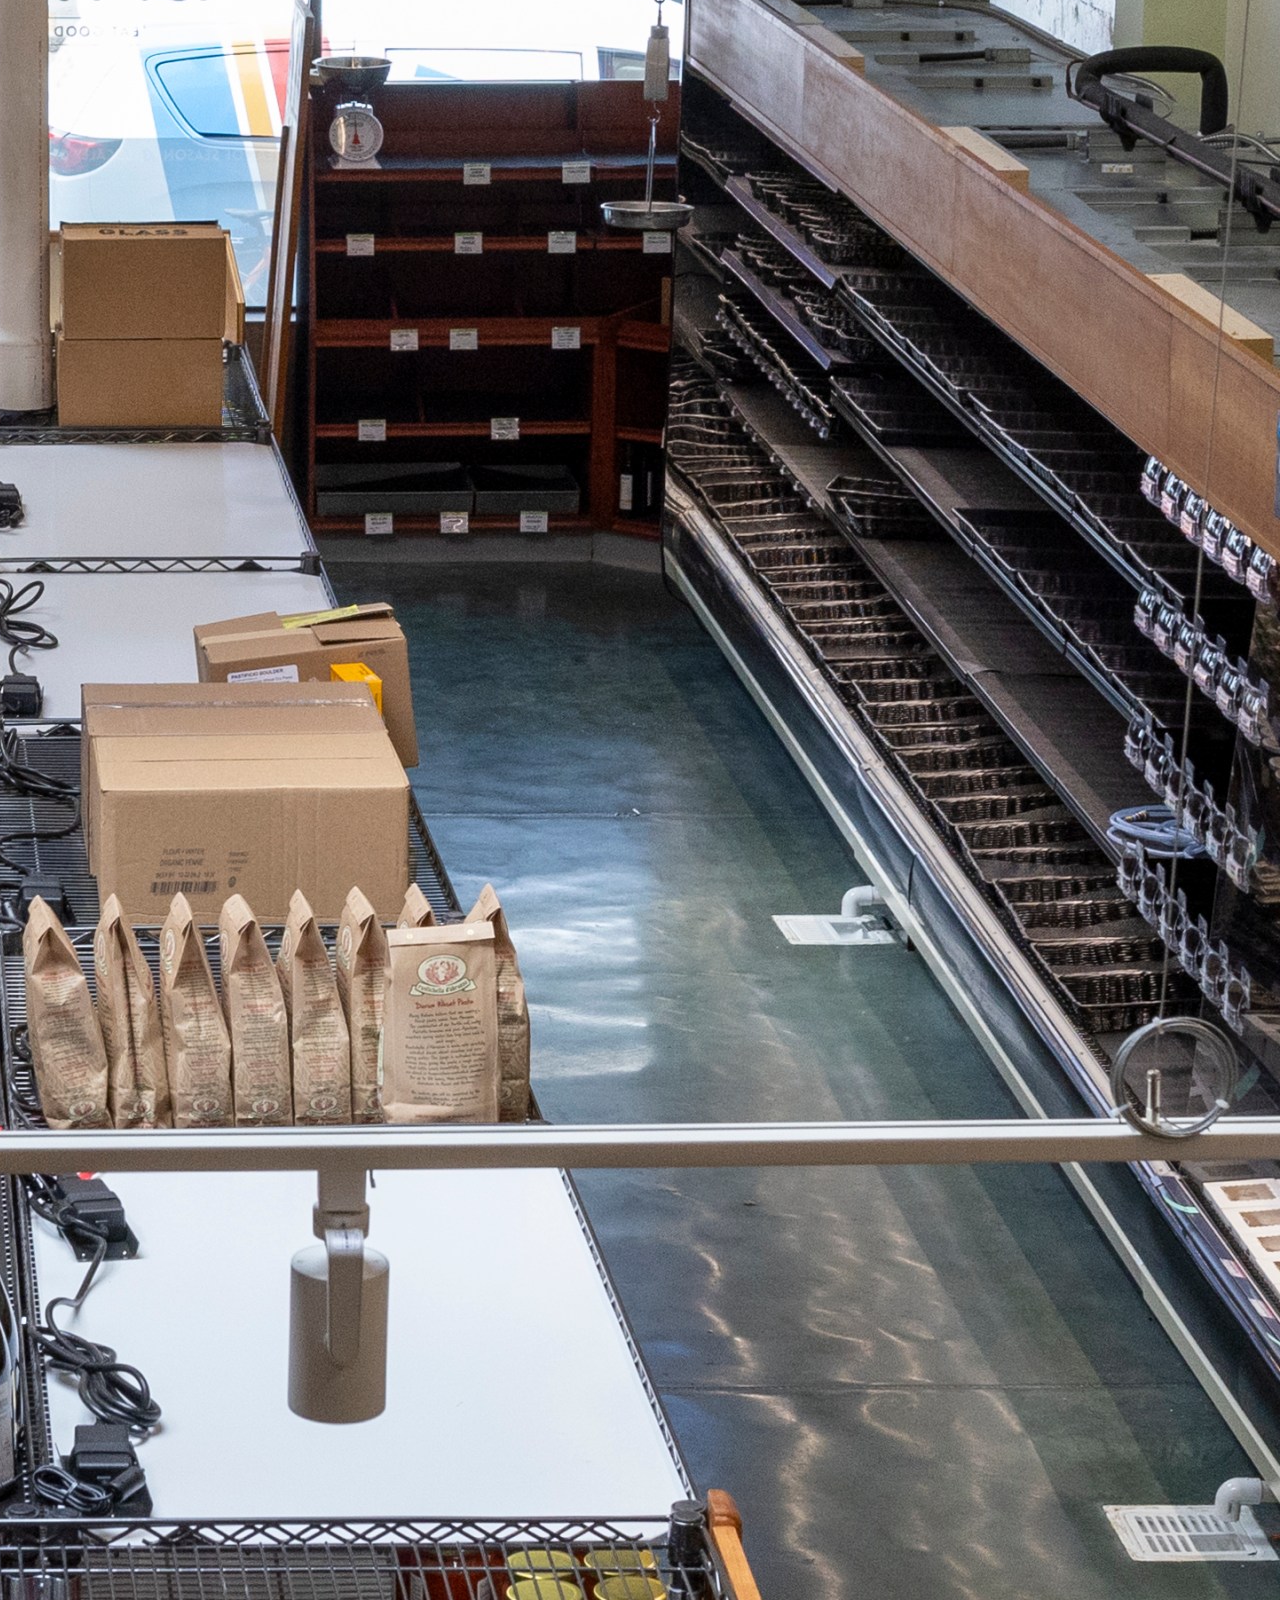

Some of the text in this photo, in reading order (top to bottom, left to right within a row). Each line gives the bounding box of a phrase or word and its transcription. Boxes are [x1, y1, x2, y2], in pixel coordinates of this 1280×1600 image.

[99, 228, 190, 237] GLASS
[416, 1001, 436, 1010] Durum
[457, 998, 474, 1007] Pasta
